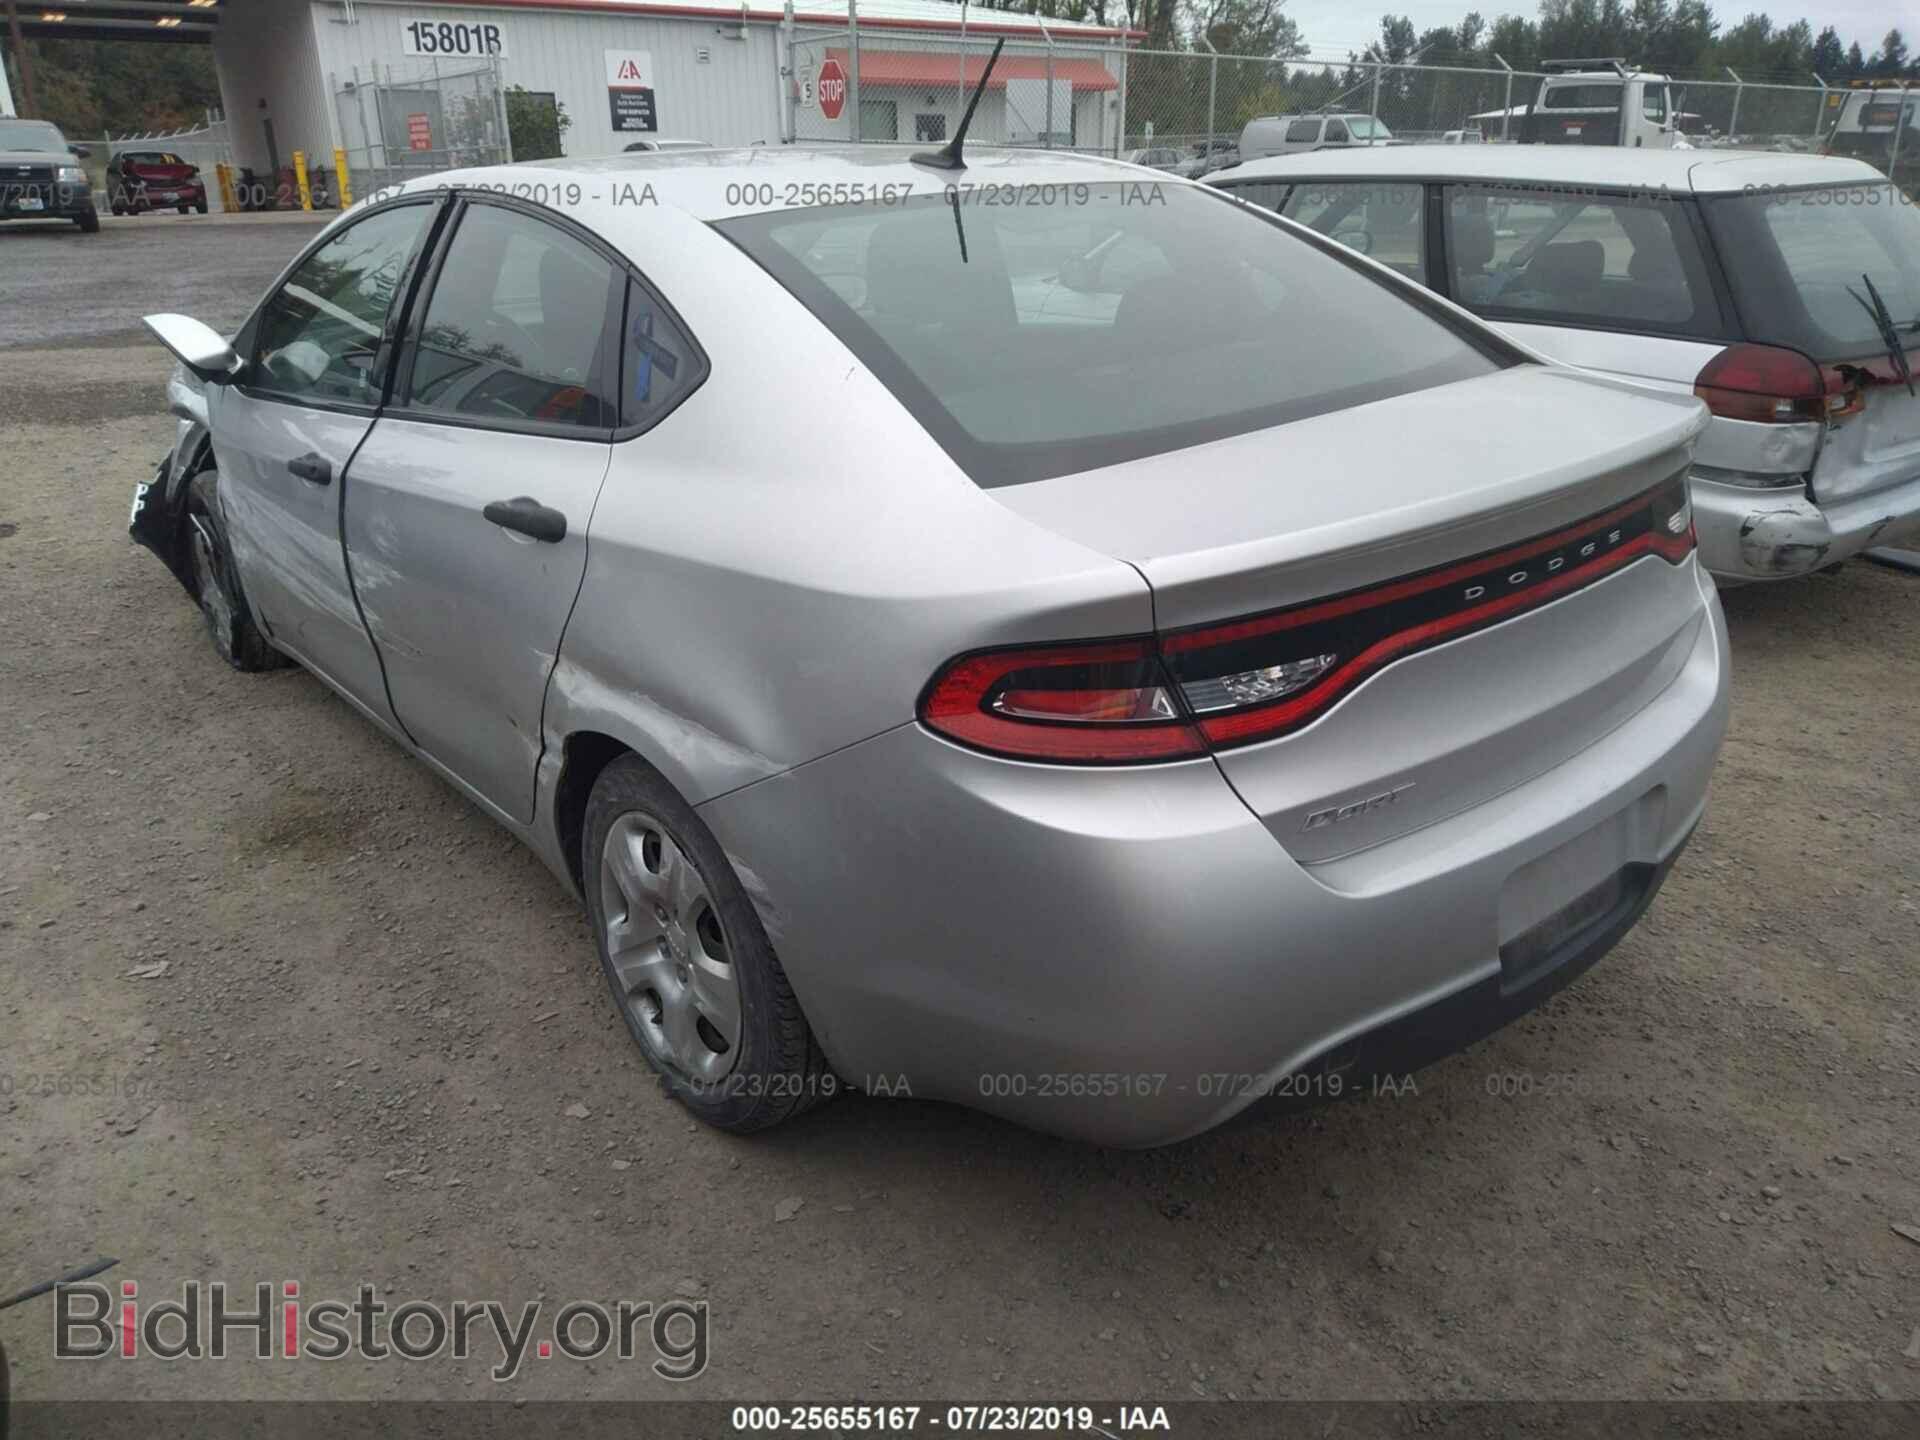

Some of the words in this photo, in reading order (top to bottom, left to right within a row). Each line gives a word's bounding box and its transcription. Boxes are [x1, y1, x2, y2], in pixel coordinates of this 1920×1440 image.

[407, 21, 502, 55] 15801B
[820, 79, 843, 102] STOP
[1464, 529, 1621, 601] DODGE
